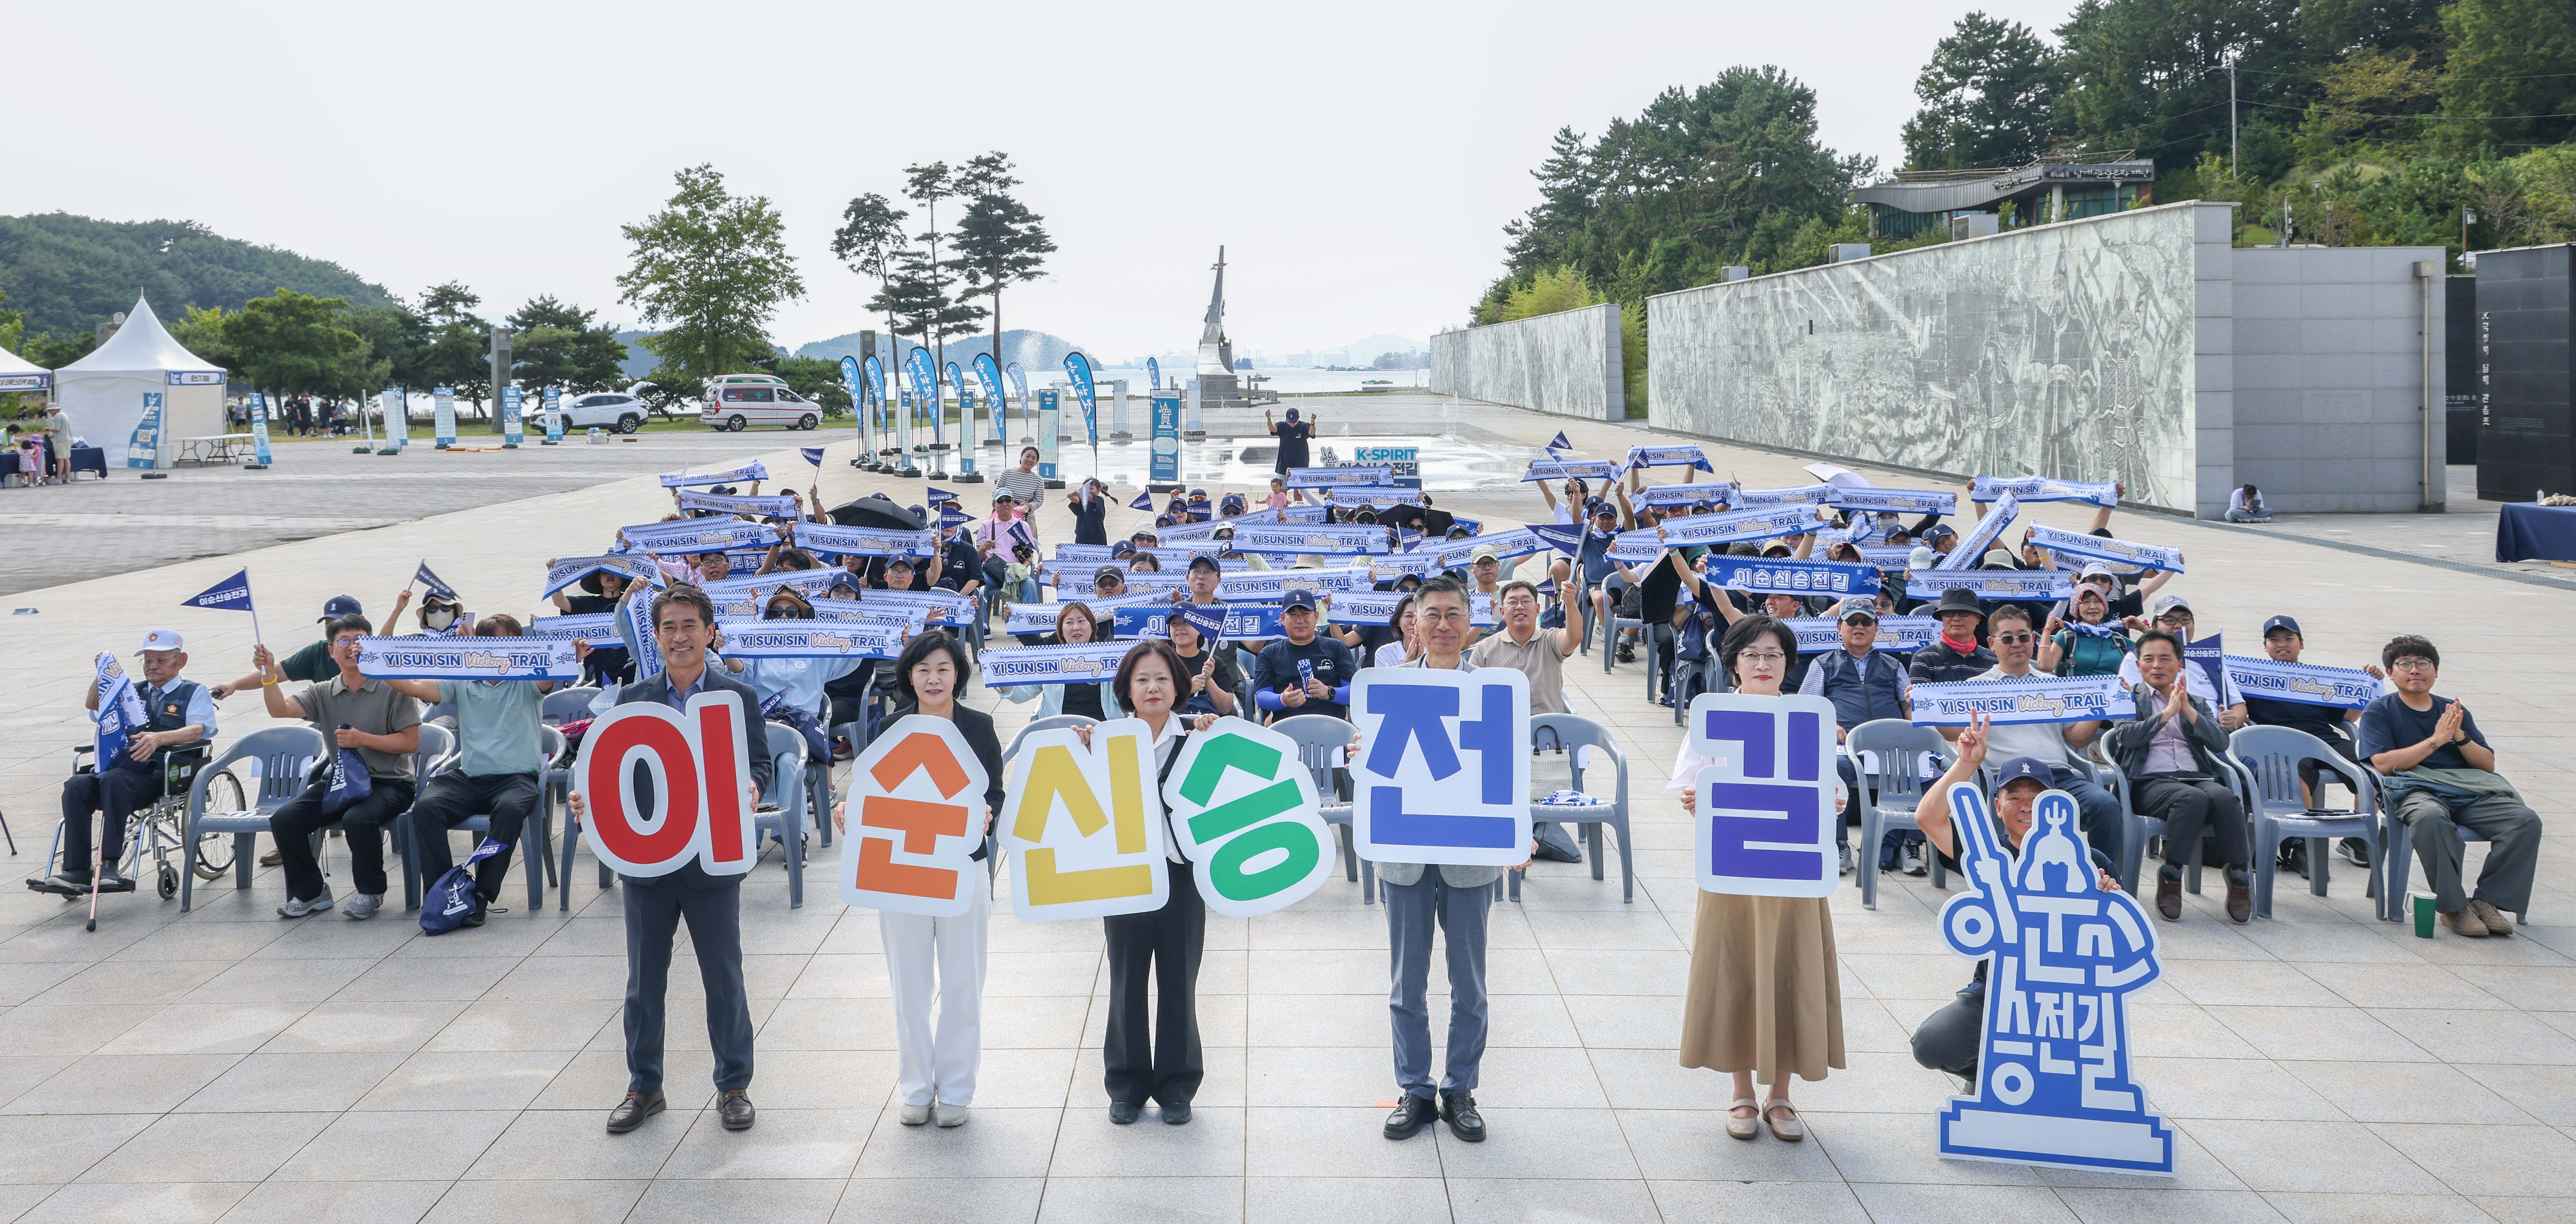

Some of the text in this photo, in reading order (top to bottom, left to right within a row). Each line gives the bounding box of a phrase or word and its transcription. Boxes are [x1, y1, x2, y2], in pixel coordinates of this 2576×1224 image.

[842, 362, 859, 409] 사천해전
[1357, 449, 1417, 460] K-SPIRIT
[1339, 473, 1360, 484] Victory
[1853, 496, 1870, 504] SUN
[1870, 497, 1888, 506] SIN
[1889, 498, 1917, 510] Victory
[1916, 499, 1940, 508] TRAIL
[1681, 515, 1803, 539] YI SUN SIN Victory TRAIL
[643, 530, 762, 548] YI SUN SIN Victory TRAIL
[820, 536, 841, 545] SUN
[841, 539, 857, 547] SIN
[861, 538, 890, 552] Victory
[891, 541, 918, 549] TRAIL
[1251, 535, 1369, 550] YI SUN SIN Victory TRAIL
[1222, 576, 1352, 593] YI SUN SIN Victory TRAIL
[1926, 579, 2053, 595] YI SUN SIN Victory TRAIL
[199, 589, 248, 606] 이순신승전길
[1184, 612, 1221, 630] 이순신승전길
[740, 633, 887, 652] YI SUN SIN Victory TRAIL
[384, 652, 550, 674] YI SUN SIN Victory TRAIL
[2184, 649, 2221, 658] 이순신승전길
[2290, 678, 2336, 700] Victory
[1940, 694, 2108, 716] YI SUN SIN Victory TRAIL
[1365, 684, 1516, 850] 전
[589, 703, 746, 866] 이
[1706, 710, 1822, 881] 길
[854, 731, 971, 901] 순
[1014, 734, 1155, 906] 신
[1179, 732, 1321, 902] 승
